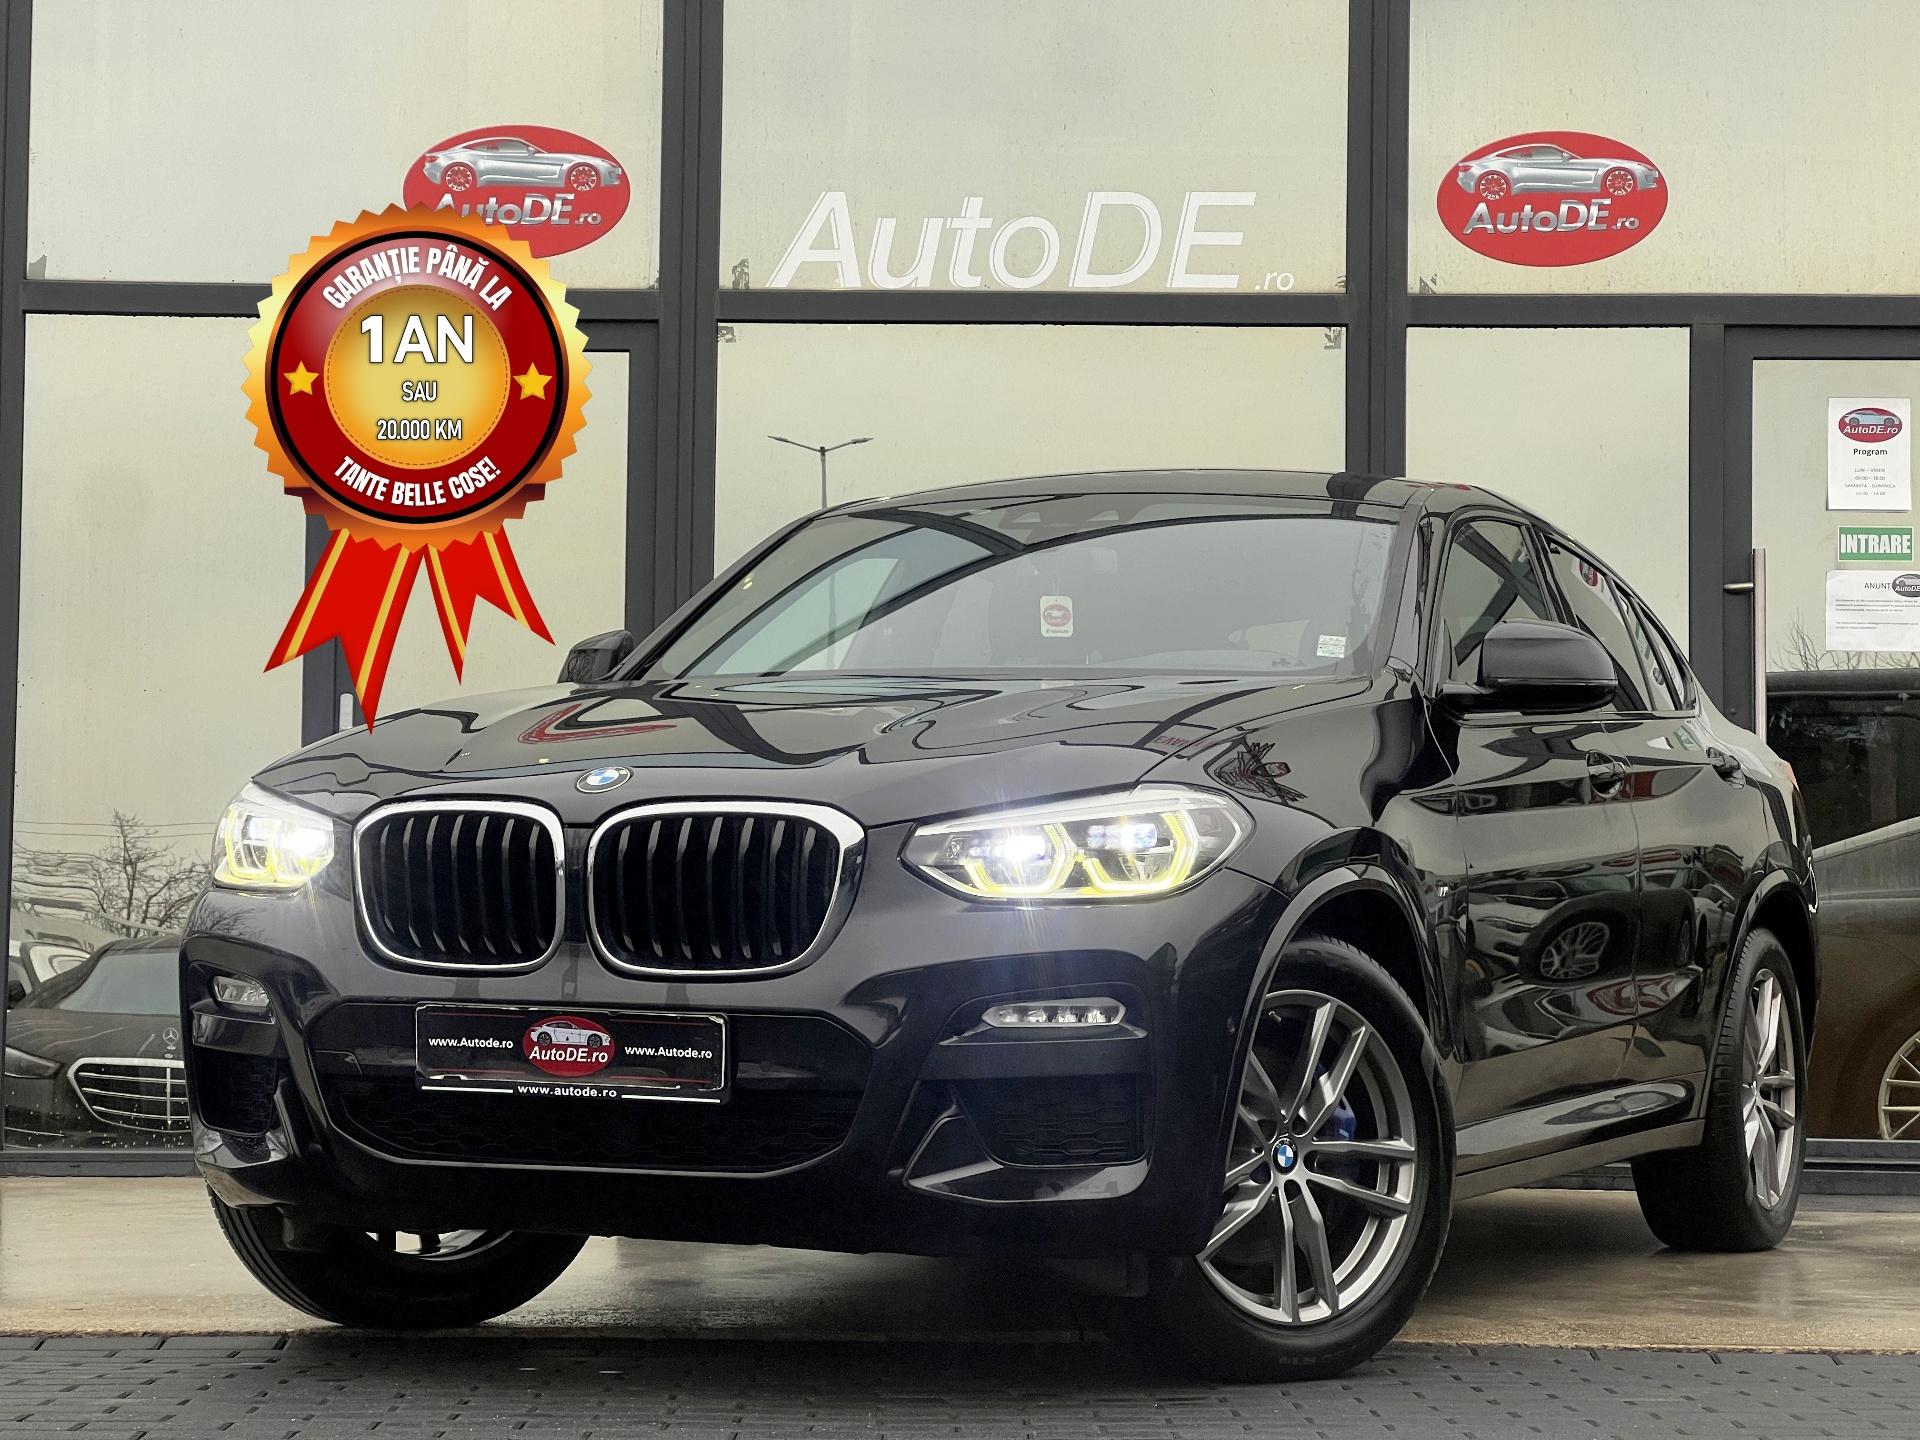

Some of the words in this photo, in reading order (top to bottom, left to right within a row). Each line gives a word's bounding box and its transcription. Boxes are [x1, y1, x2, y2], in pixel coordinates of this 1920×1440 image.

[1843, 425, 1898, 434] AutoDE.ro
[1853, 448, 1888, 457] Program
[1840, 534, 1911, 554] INTRARE
[428, 1036, 514, 1049] www.Autode.ro
[528, 1045, 609, 1064] AutoDE.ro
[624, 1044, 713, 1059] www.Autode.ro
[517, 1083, 618, 1098] www.autode.ro
